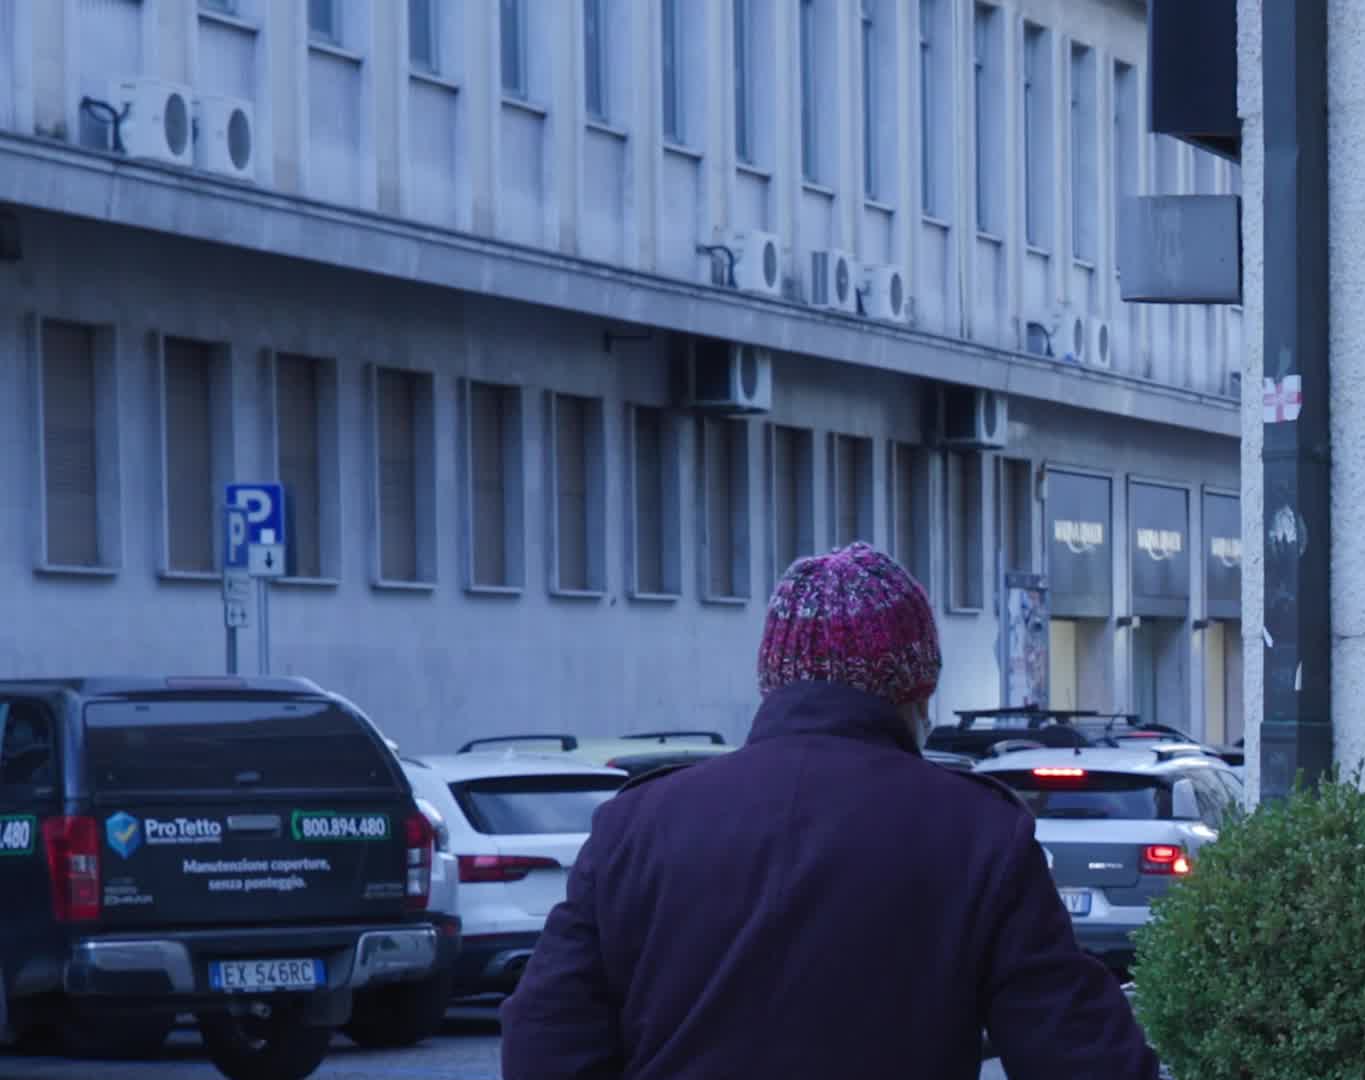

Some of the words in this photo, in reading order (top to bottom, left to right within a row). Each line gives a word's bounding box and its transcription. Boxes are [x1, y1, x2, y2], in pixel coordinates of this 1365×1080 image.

[144, 817, 223, 837] ProTetto
[302, 817, 386, 837] 800.894.480
[181, 857, 269, 875] Manutenzione
[207, 878, 243, 892] senza
[223, 961, 248, 986] EX
[255, 959, 313, 984] 546RC
